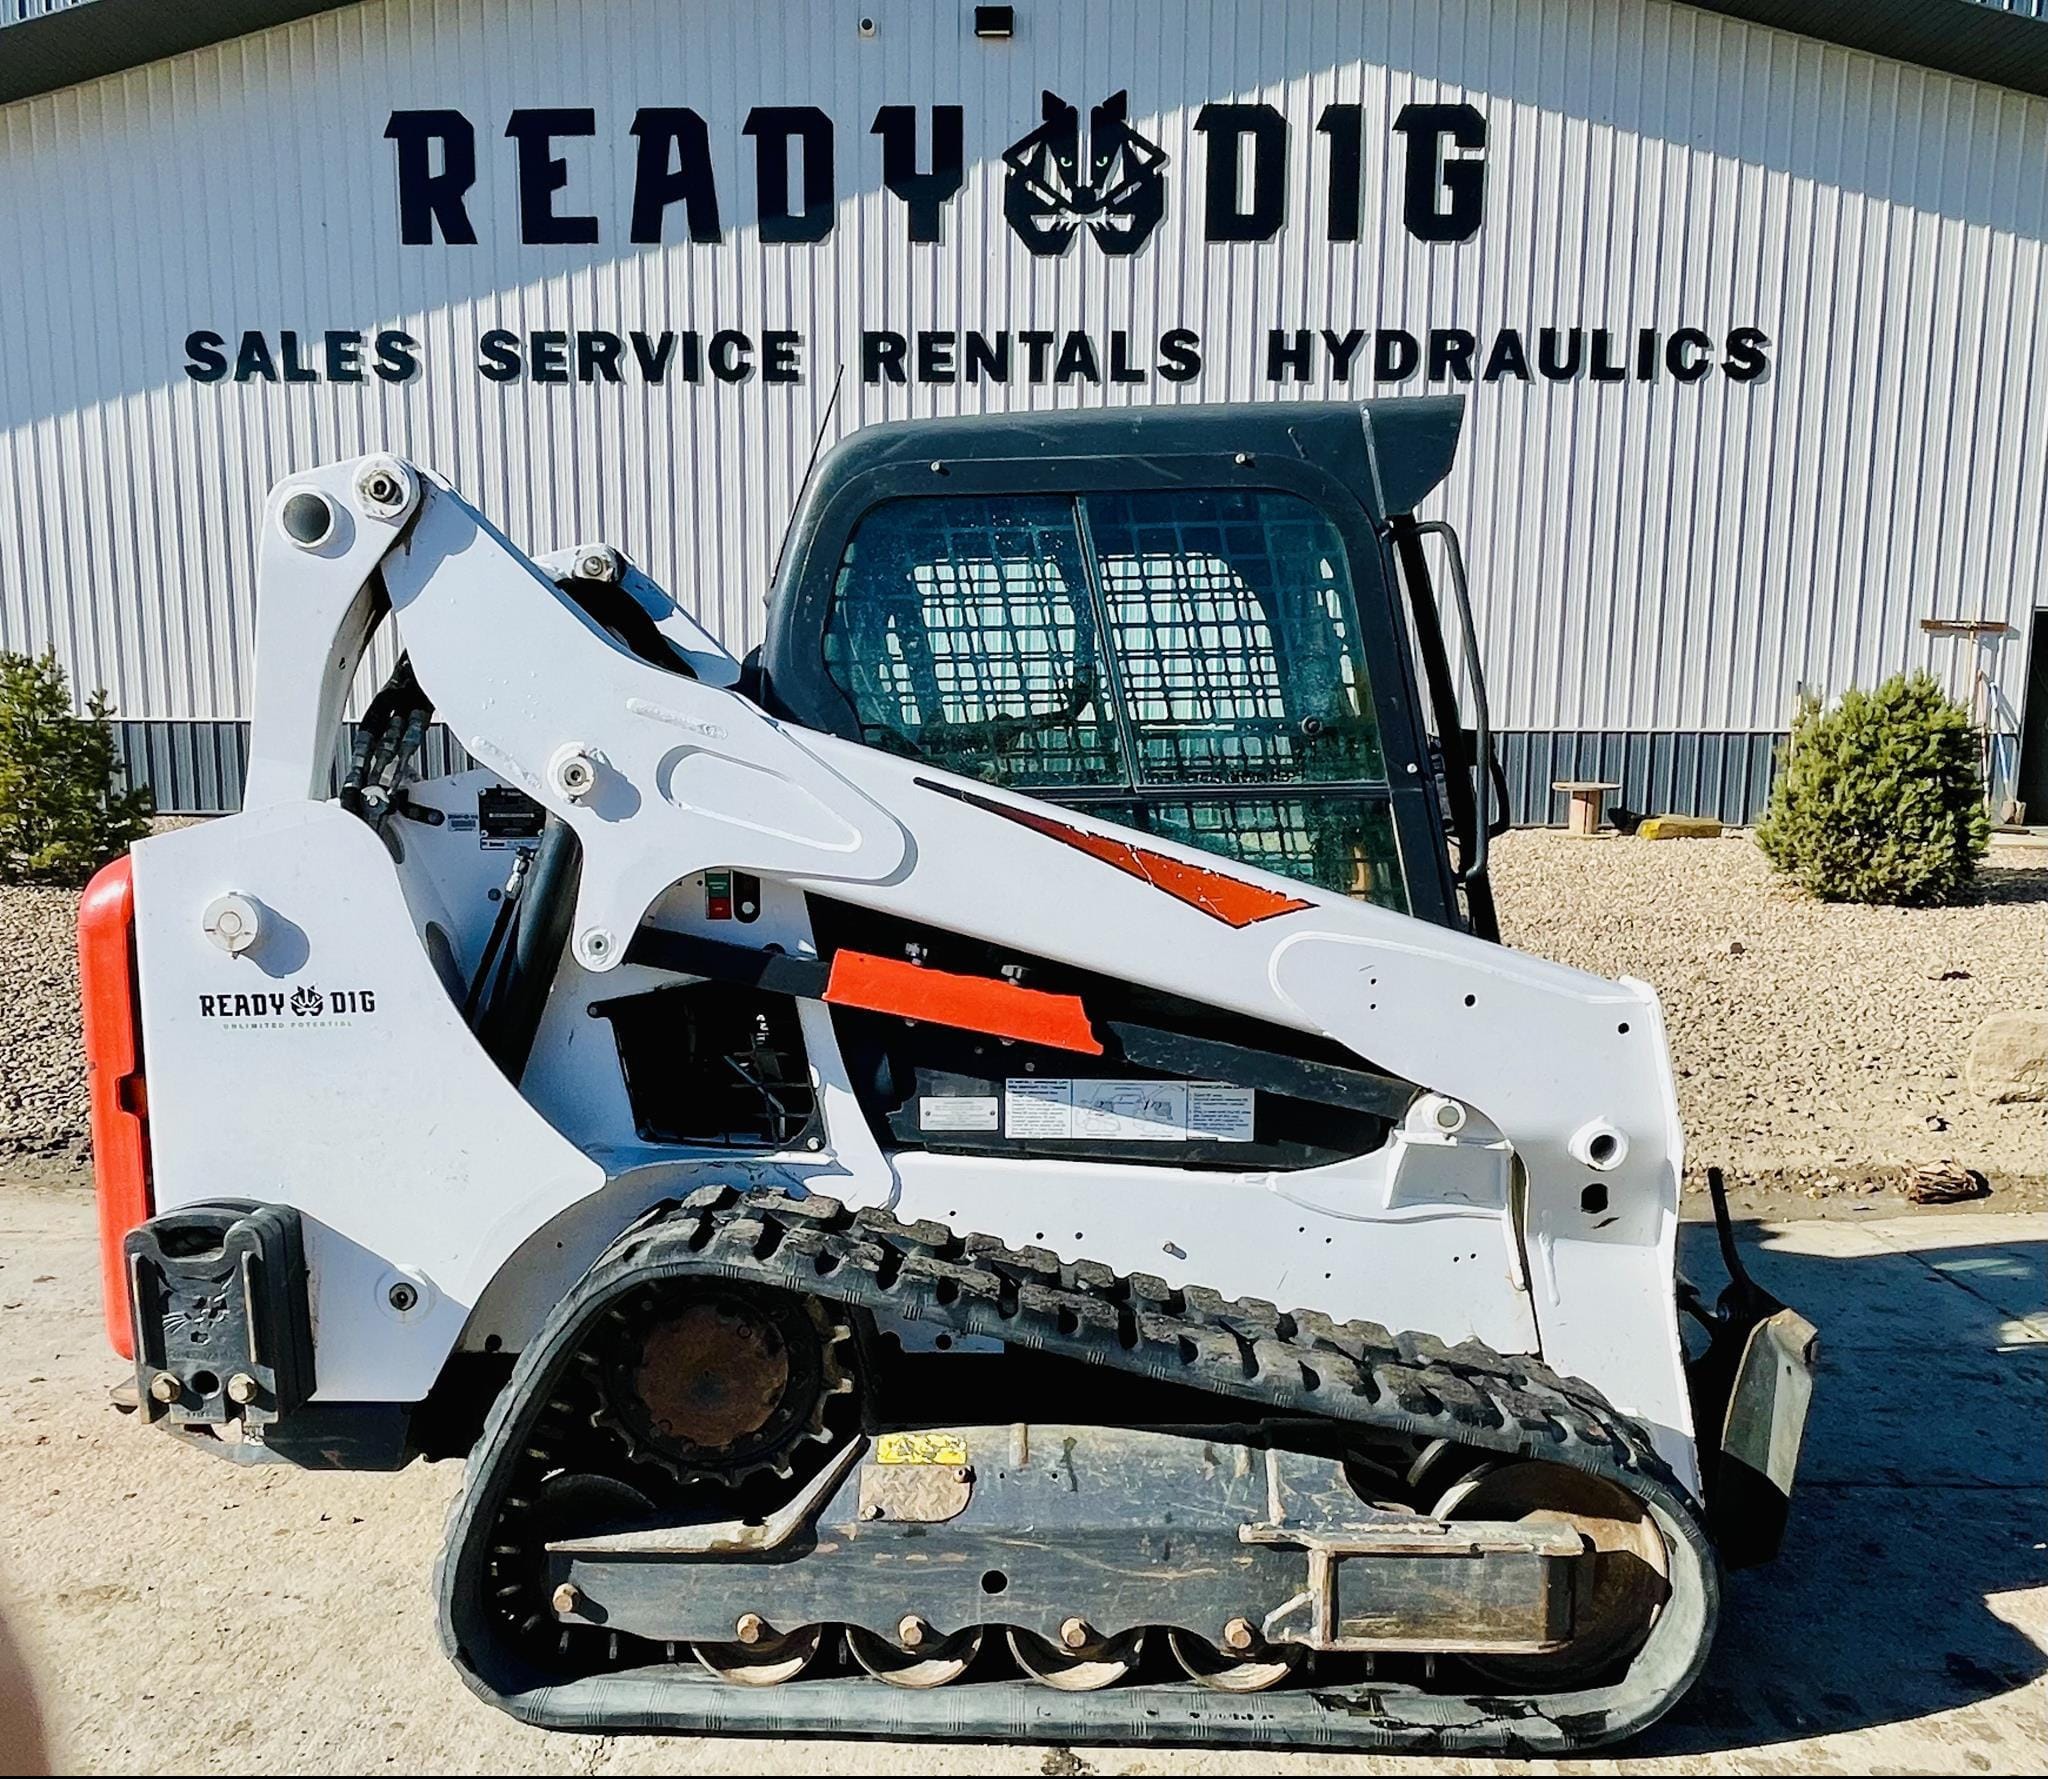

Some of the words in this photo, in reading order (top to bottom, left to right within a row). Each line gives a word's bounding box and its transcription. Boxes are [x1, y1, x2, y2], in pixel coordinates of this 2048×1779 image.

[384, 105, 964, 244] READY
[1193, 103, 1488, 243] DIG
[184, 329, 421, 382] SALES
[477, 329, 801, 384] SERVICE
[863, 328, 1203, 383] RENTALS
[1267, 327, 1771, 383] HYDRAULICS
[199, 993, 284, 1016] READY
[329, 991, 375, 1013] DIG
